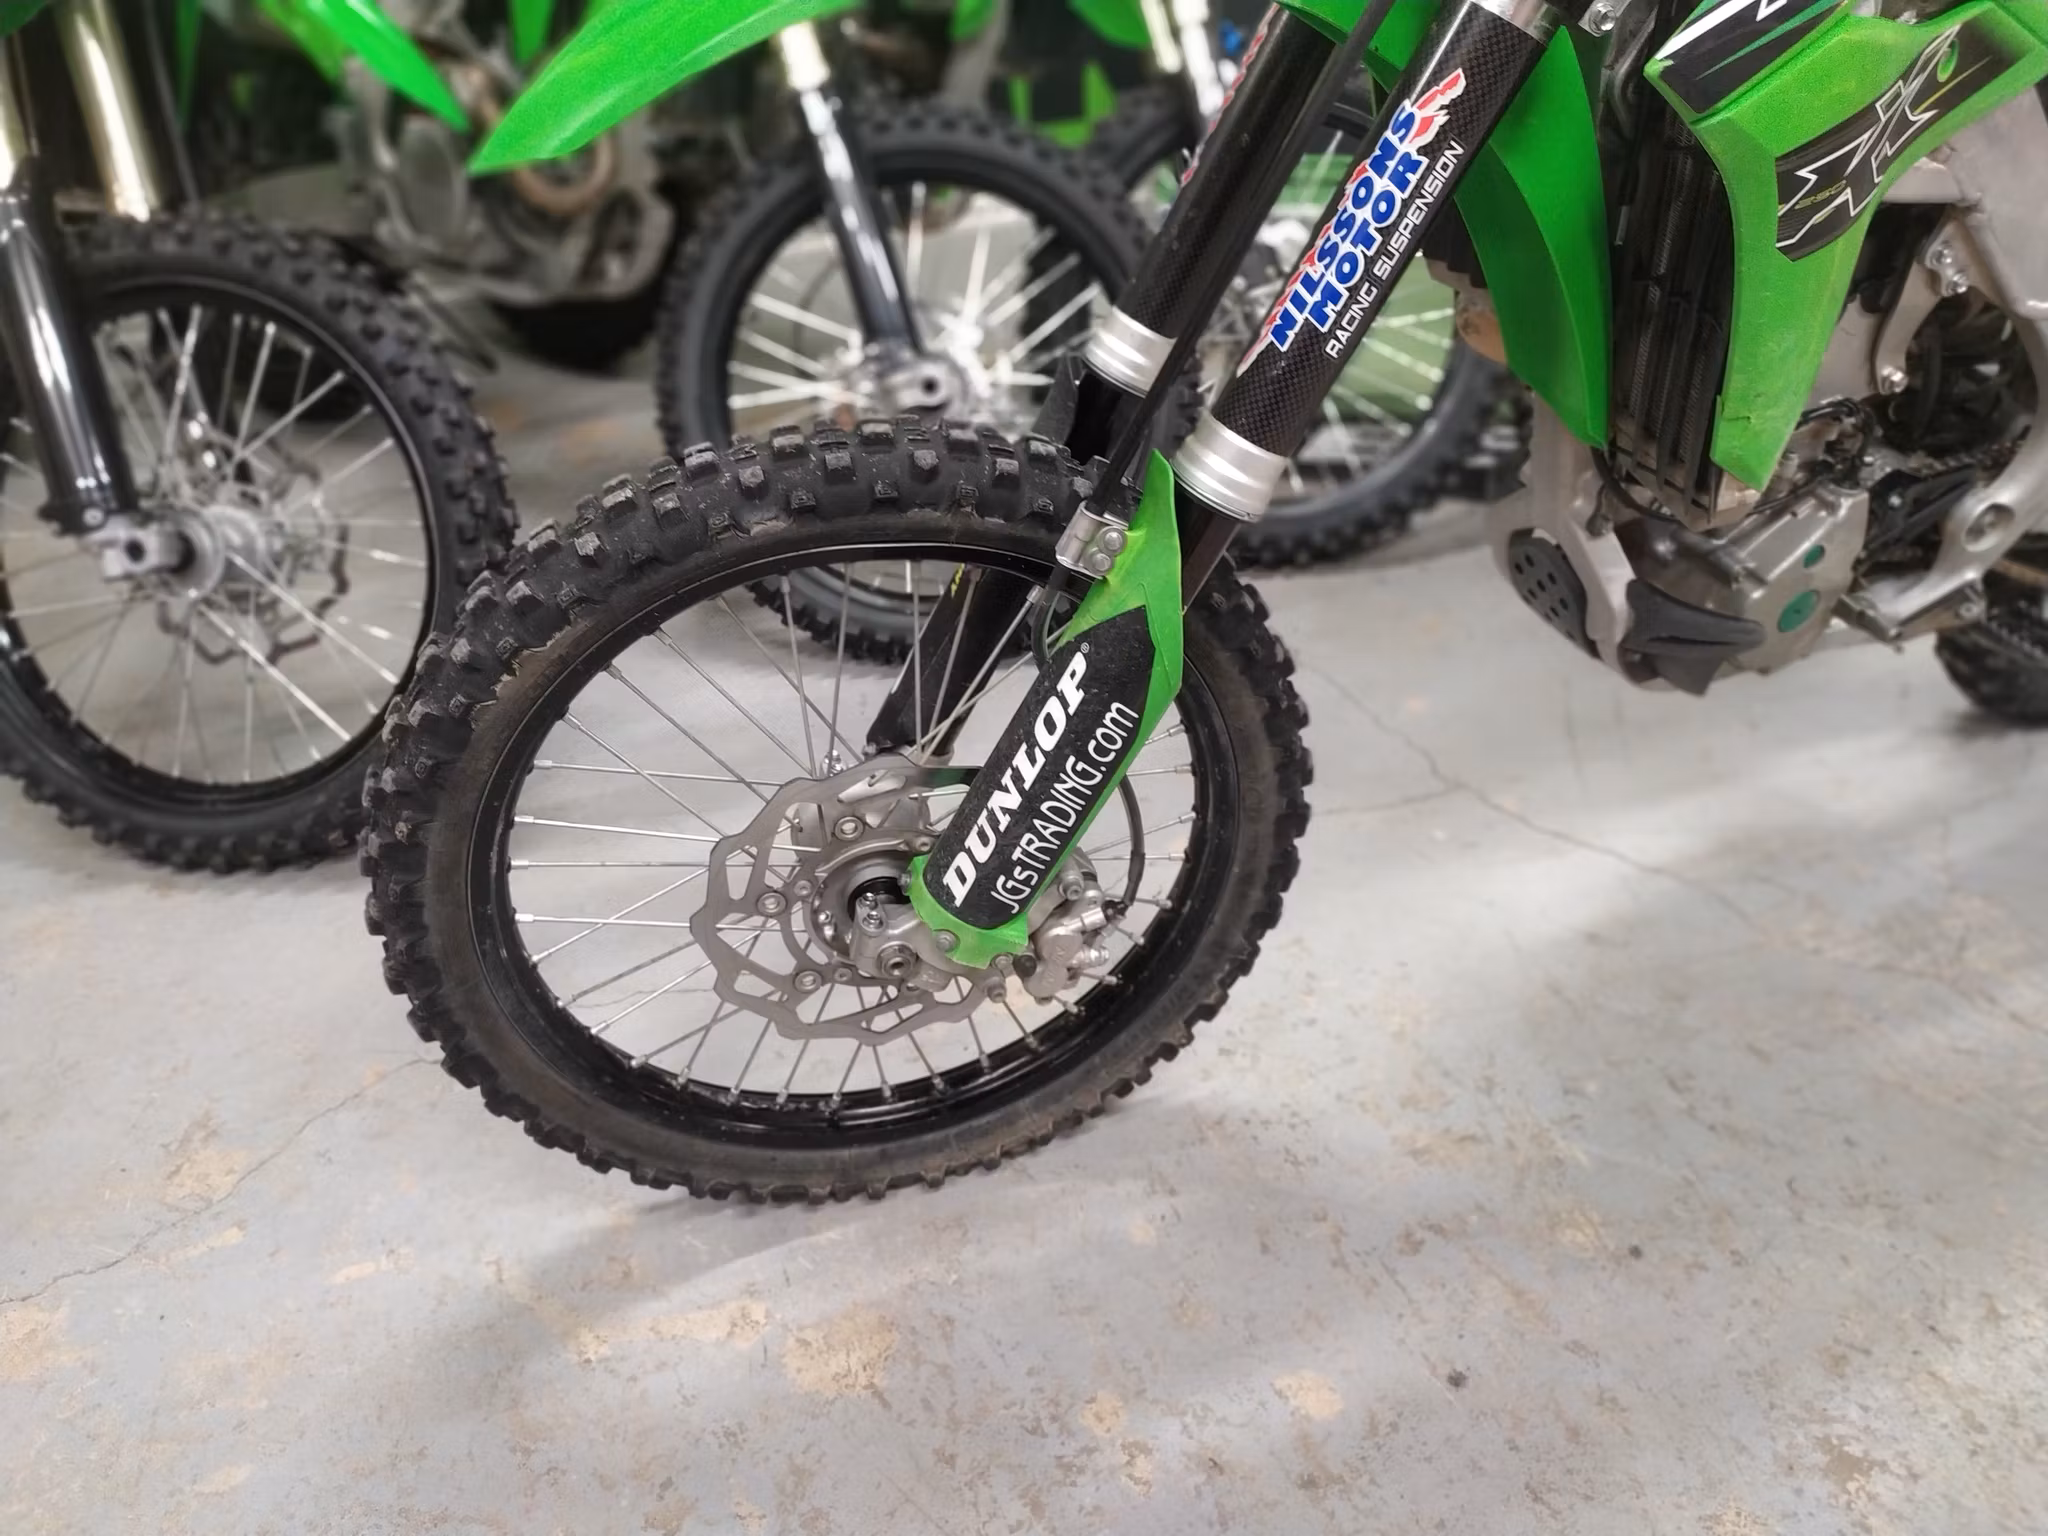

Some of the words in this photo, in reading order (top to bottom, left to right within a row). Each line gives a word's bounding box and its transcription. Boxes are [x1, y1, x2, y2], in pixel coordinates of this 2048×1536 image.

[1270, 100, 1417, 351] NILSSONS
[1307, 149, 1429, 332] MOTOR
[1326, 282, 1377, 358] RACING
[1375, 141, 1464, 280] SUSPENSION
[942, 650, 1088, 908] DUNLOP
